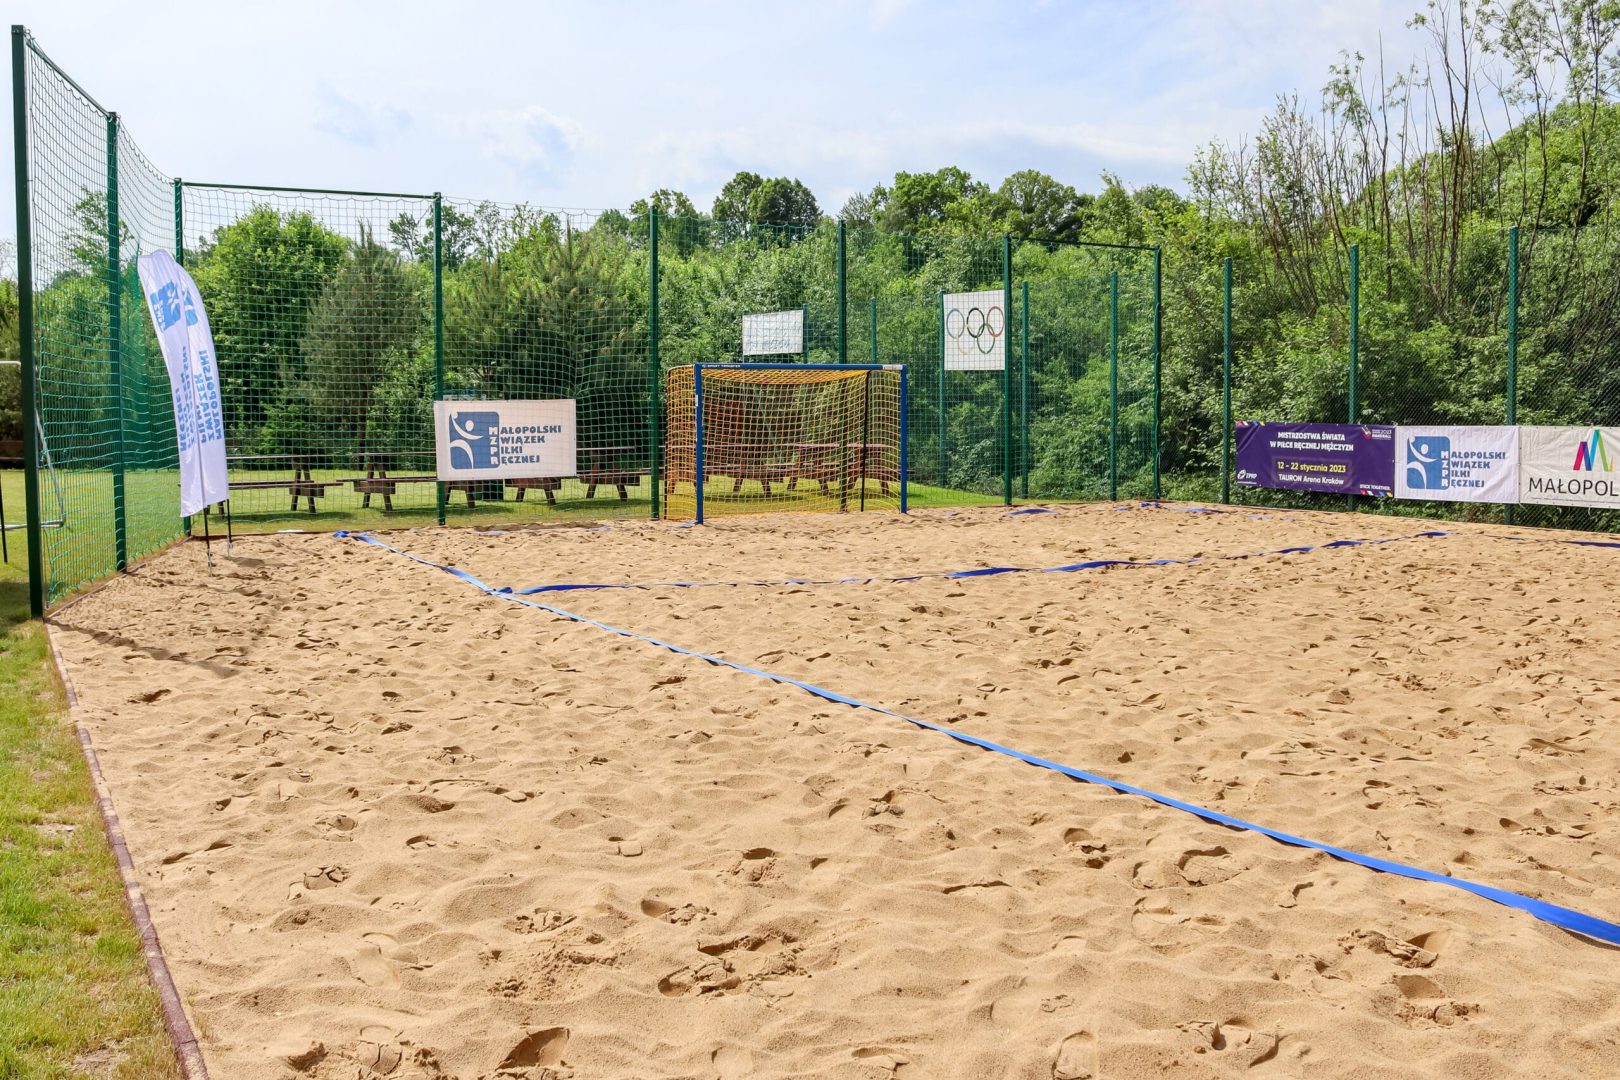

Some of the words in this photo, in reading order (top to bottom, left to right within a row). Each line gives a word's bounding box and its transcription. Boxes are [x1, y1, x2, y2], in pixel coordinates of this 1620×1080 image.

[488, 425, 561, 435] MAŁOPOLSKI
[489, 435, 546, 445] ZWIĄZEK
[1277, 431, 1321, 440] MISTRZOSTWA
[1321, 432, 1346, 441] ŚWIATA
[490, 446, 523, 455] PIŁKI
[1277, 441, 1293, 449] PIŁCE
[1294, 441, 1321, 451] RĘCZNEJ
[1321, 442, 1354, 452] MĘŻCZYZN
[490, 455, 540, 465] RĘCZNEJ
[1441, 451, 1506, 459] MAŁOPOLSKI
[1277, 461, 1285, 469] 12
[1290, 462, 1299, 470] 22
[1299, 463, 1328, 472] stycznia
[1328, 464, 1346, 473] 2023
[1442, 460, 1490, 469] ZWIĄZEK
[1279, 473, 1302, 482] TAURON
[1302, 475, 1321, 483] Arena
[1321, 476, 1344, 485] Kraków
[1442, 479, 1485, 488] RĘCZNEJ
[1528, 477, 1619, 497] MAŁOPOL
